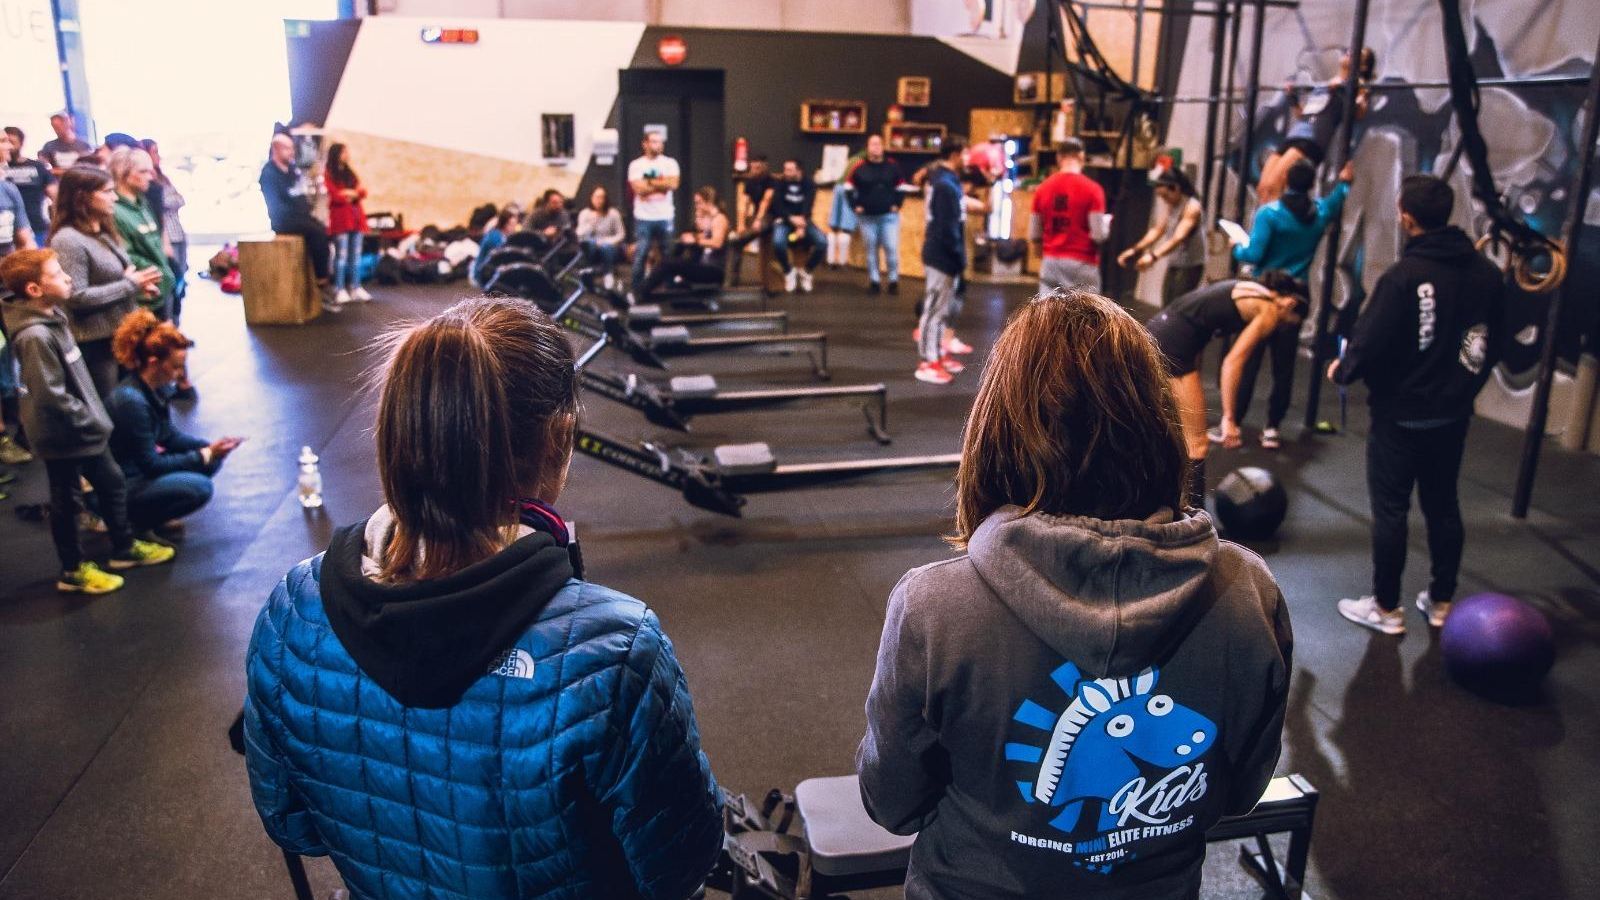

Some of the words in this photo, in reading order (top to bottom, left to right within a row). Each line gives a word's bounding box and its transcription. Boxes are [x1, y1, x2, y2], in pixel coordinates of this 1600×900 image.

[1109, 762, 1208, 826] Kids
[1011, 830, 1073, 853] FORGING
[1075, 836, 1107, 854] MINI
[1108, 827, 1141, 848] ELITE
[1142, 814, 1194, 838] FITNESS
